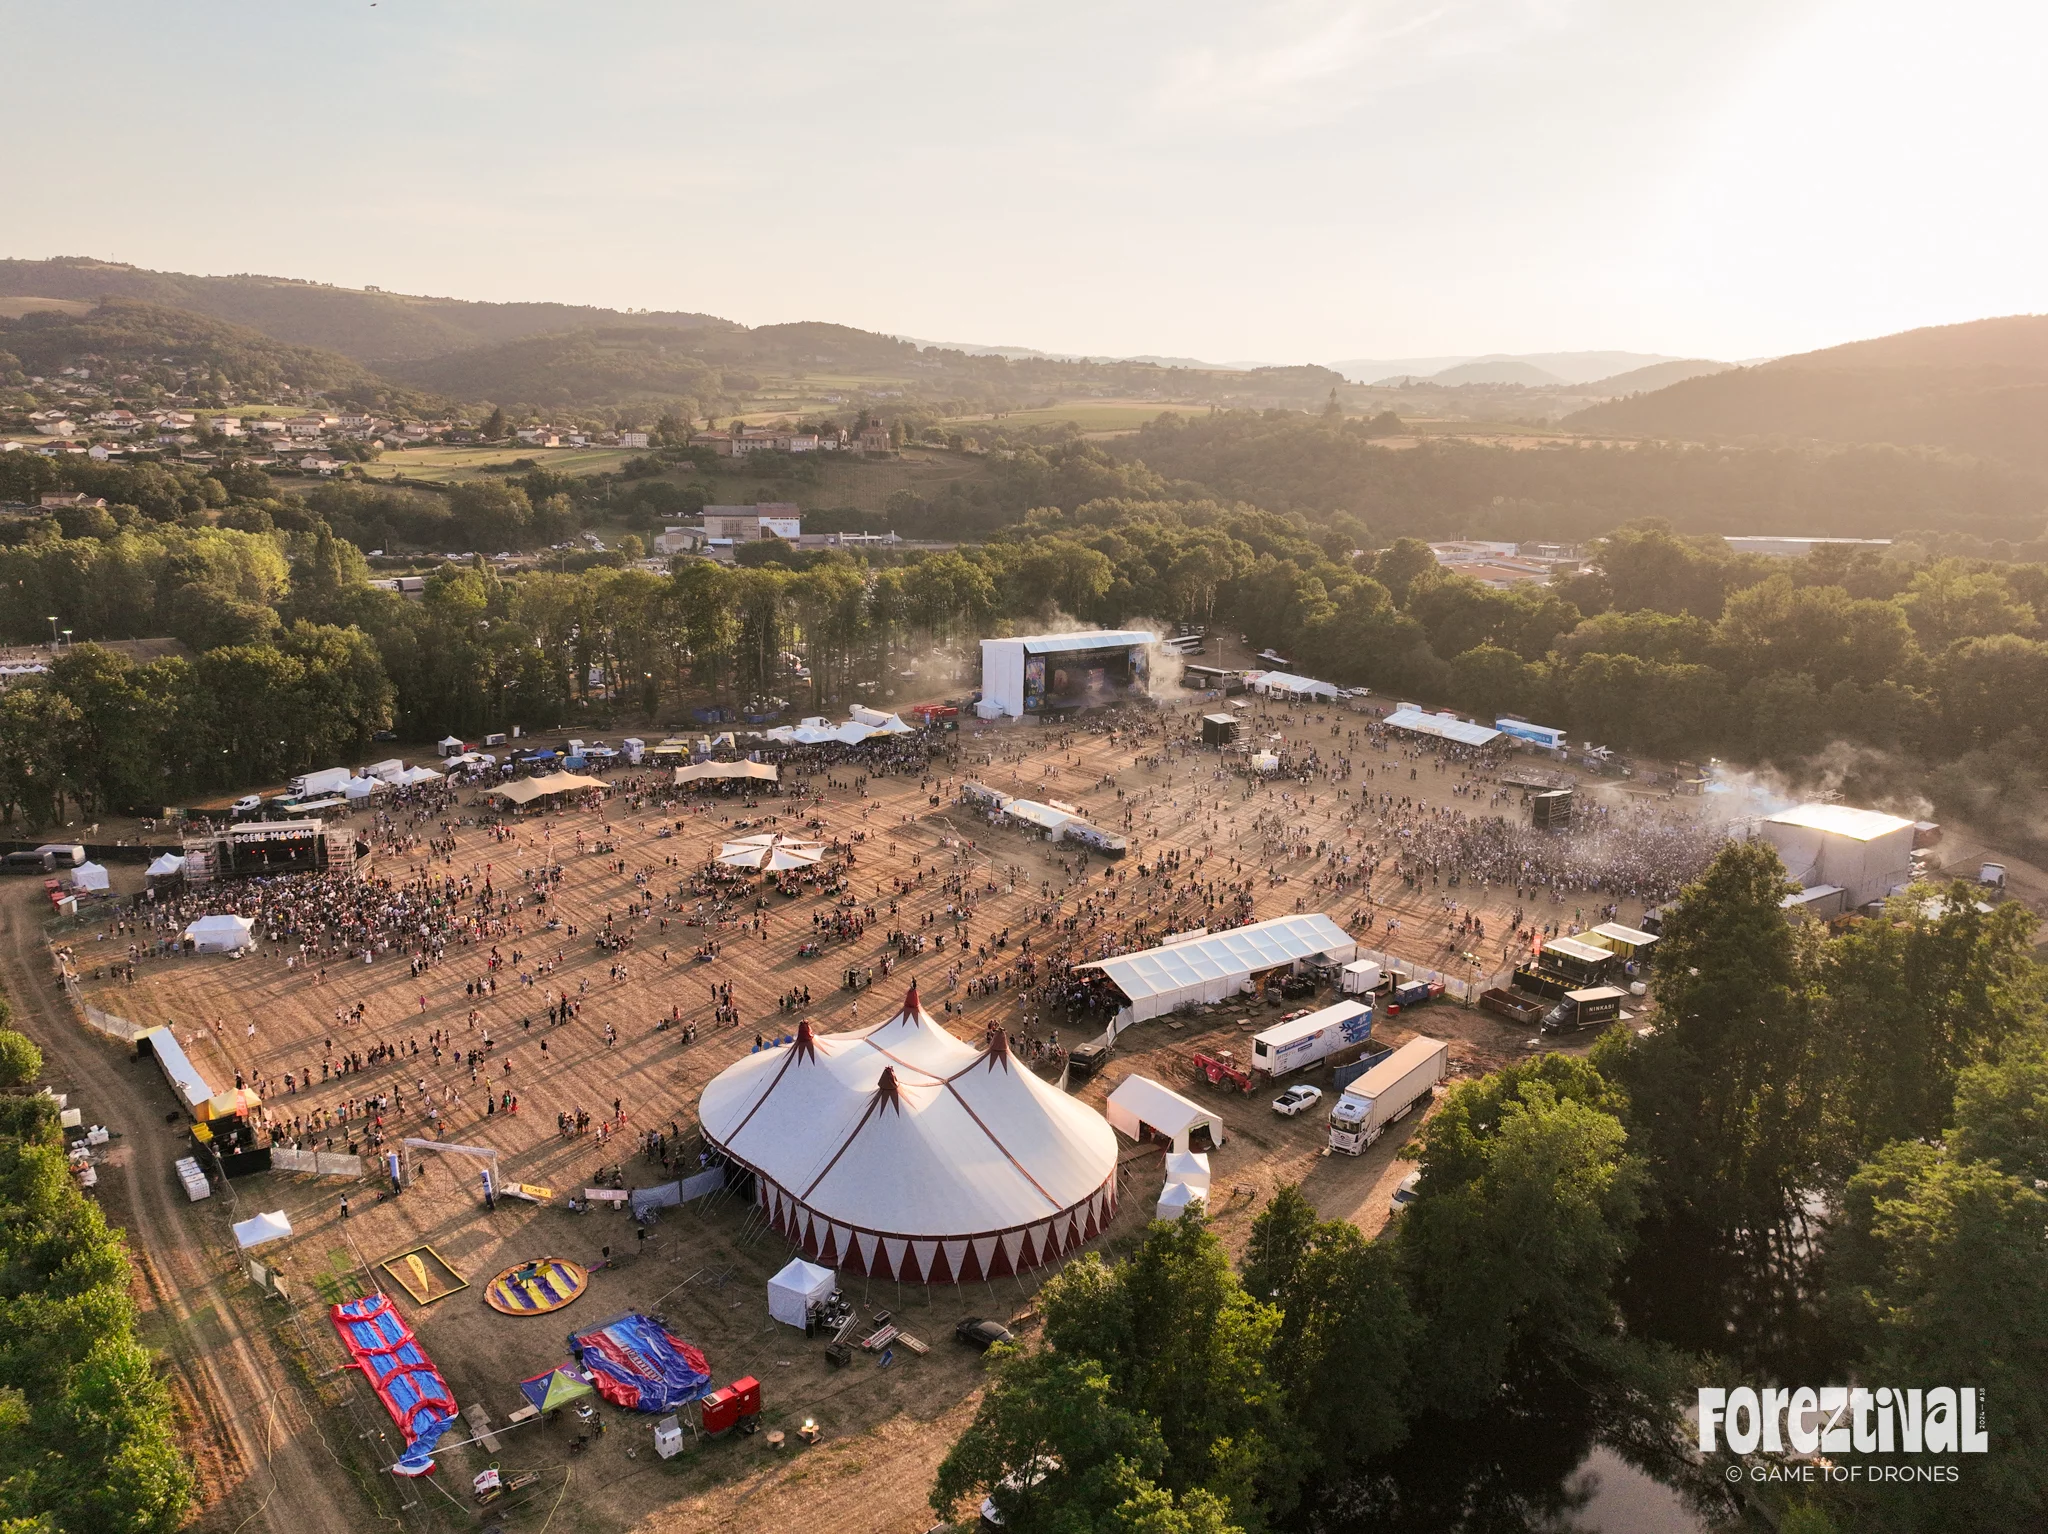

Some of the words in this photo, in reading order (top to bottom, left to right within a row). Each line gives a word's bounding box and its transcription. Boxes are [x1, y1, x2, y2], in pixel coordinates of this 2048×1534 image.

[235, 833, 267, 843] SCENE
[270, 829, 312, 840] MAGMA
[1589, 1003, 1615, 1012] NINKASI
